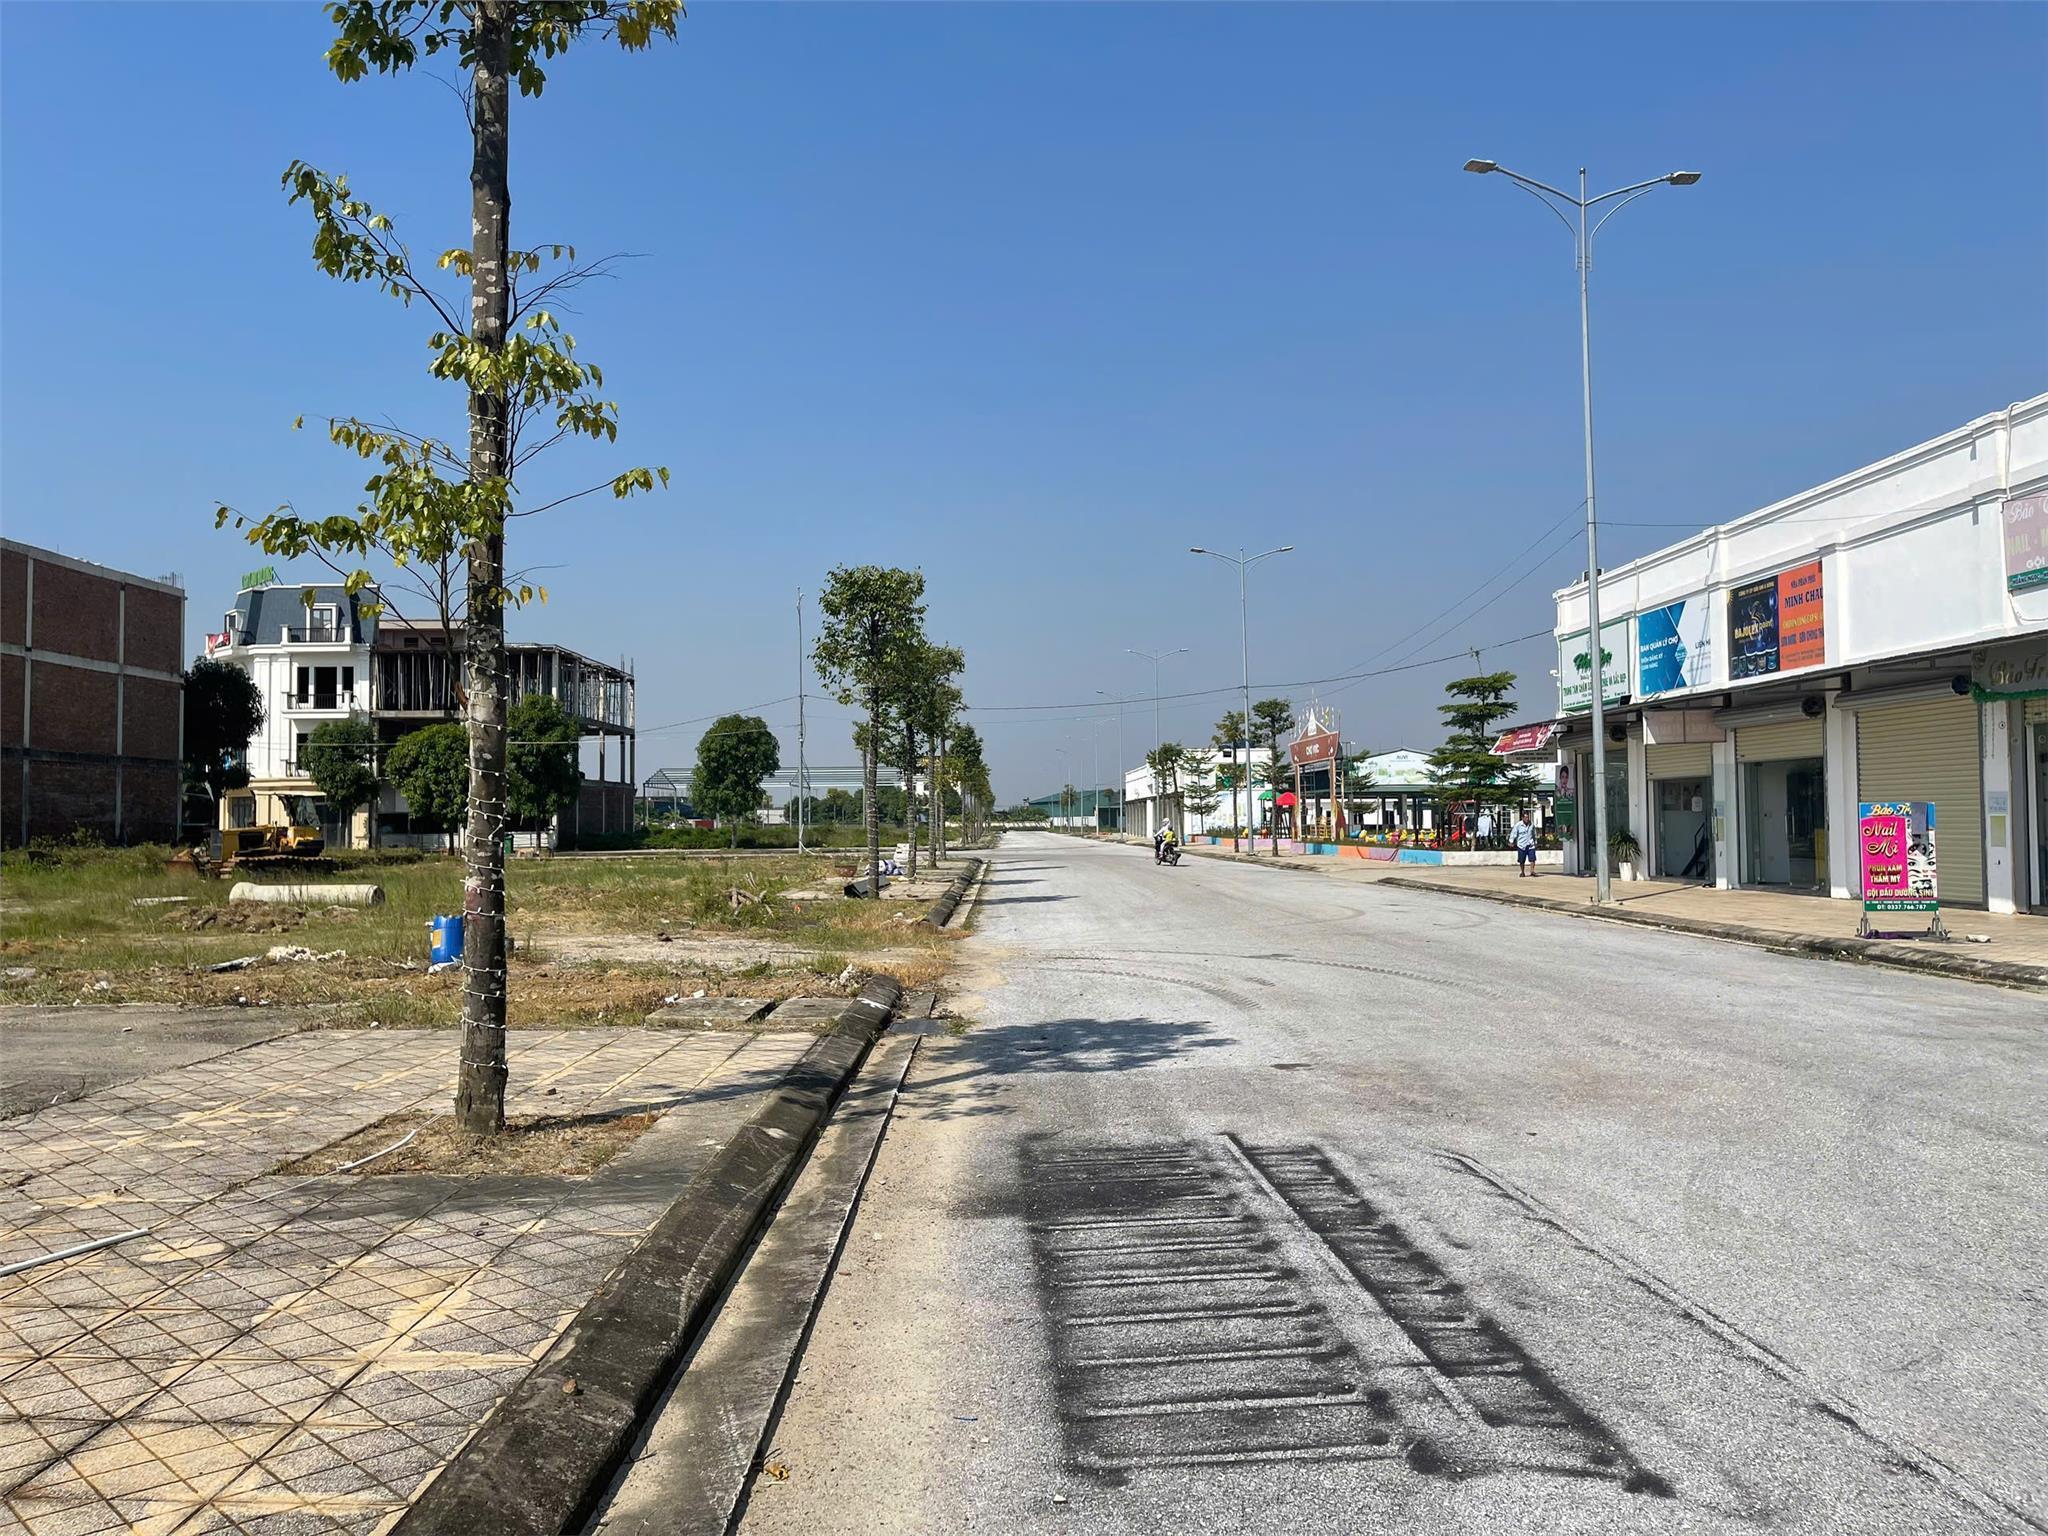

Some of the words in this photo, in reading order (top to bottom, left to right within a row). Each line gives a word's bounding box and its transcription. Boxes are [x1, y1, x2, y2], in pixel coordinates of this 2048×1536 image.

[2007, 502, 2034, 524] Bảo
[2026, 556, 2046, 569] GỘI
[1785, 593, 1803, 608] MINH
[1650, 639, 1662, 651] QUẢN
[1668, 635, 1678, 645] CHỢ
[1867, 803, 1893, 815] Bảo
[1863, 821, 1897, 837] Nail
